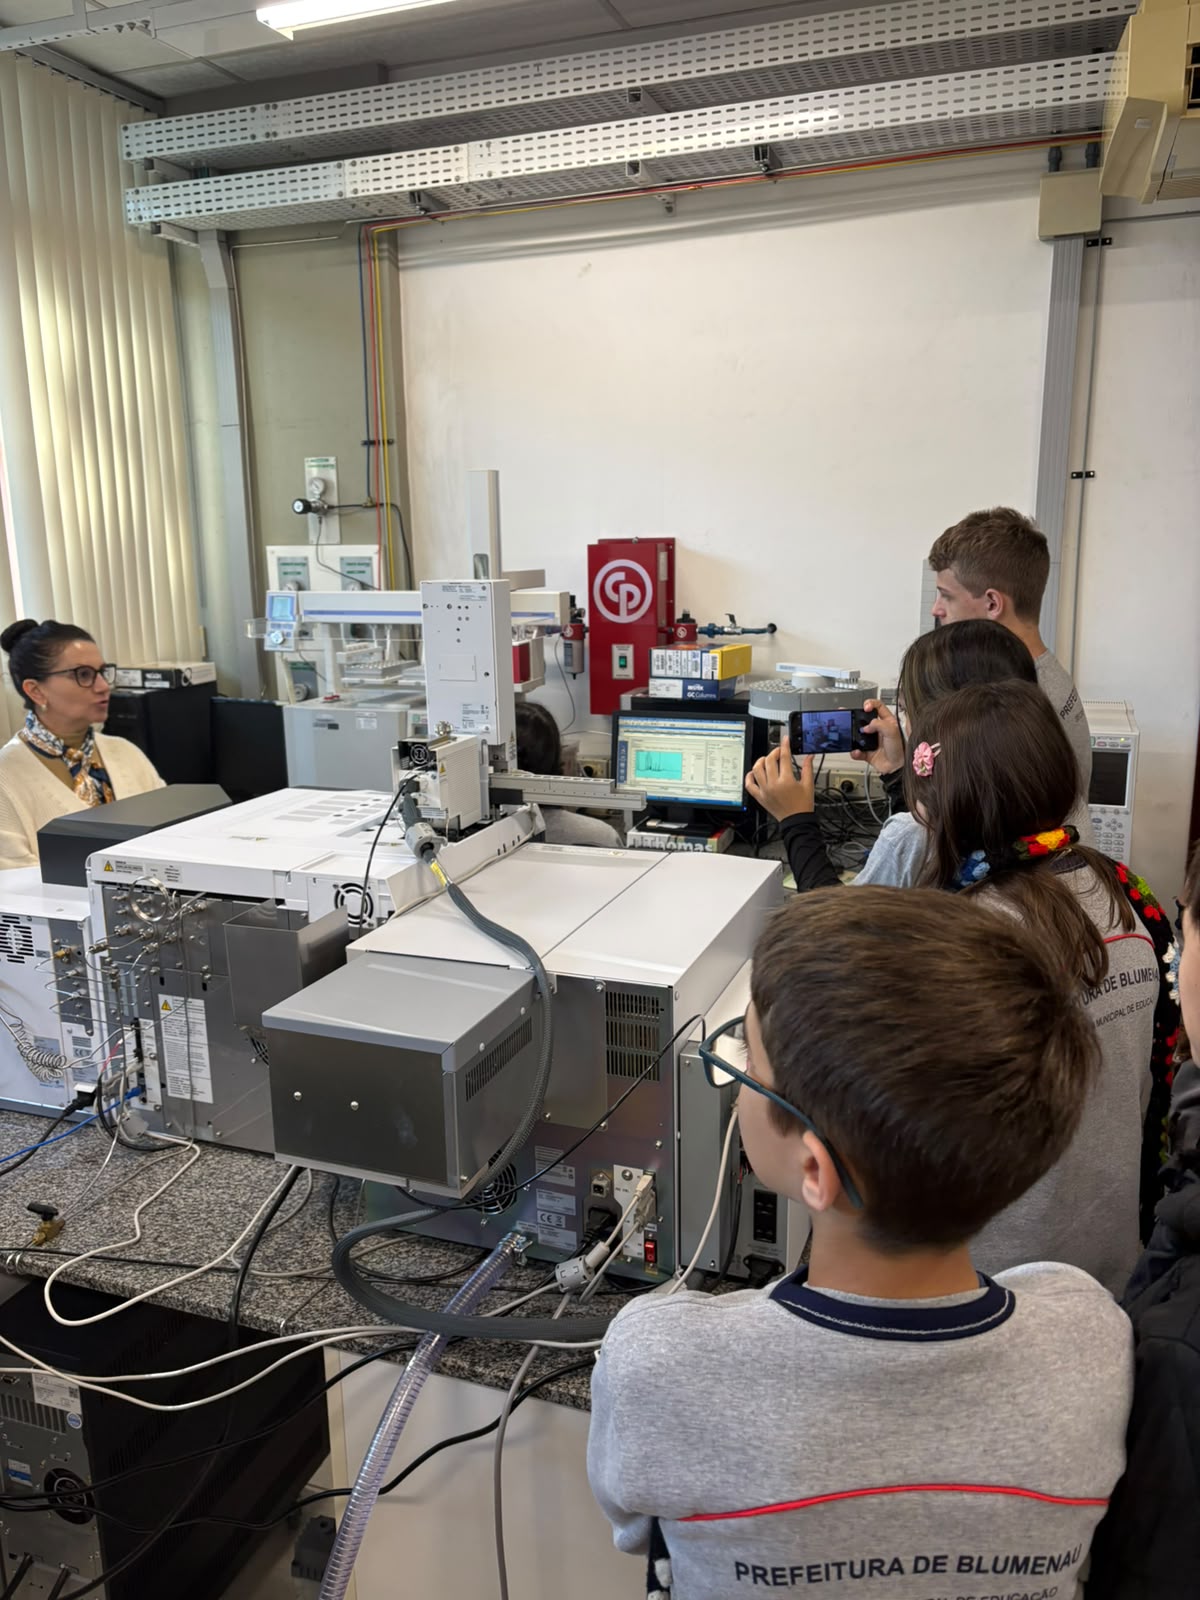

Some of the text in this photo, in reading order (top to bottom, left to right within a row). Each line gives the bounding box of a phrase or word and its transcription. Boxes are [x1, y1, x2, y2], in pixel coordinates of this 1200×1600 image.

[1104, 976, 1118, 993] DE
[1127, 1003, 1135, 1015] DE
[734, 1543, 1082, 1587] PREFEITURA DE BLUMENAU
